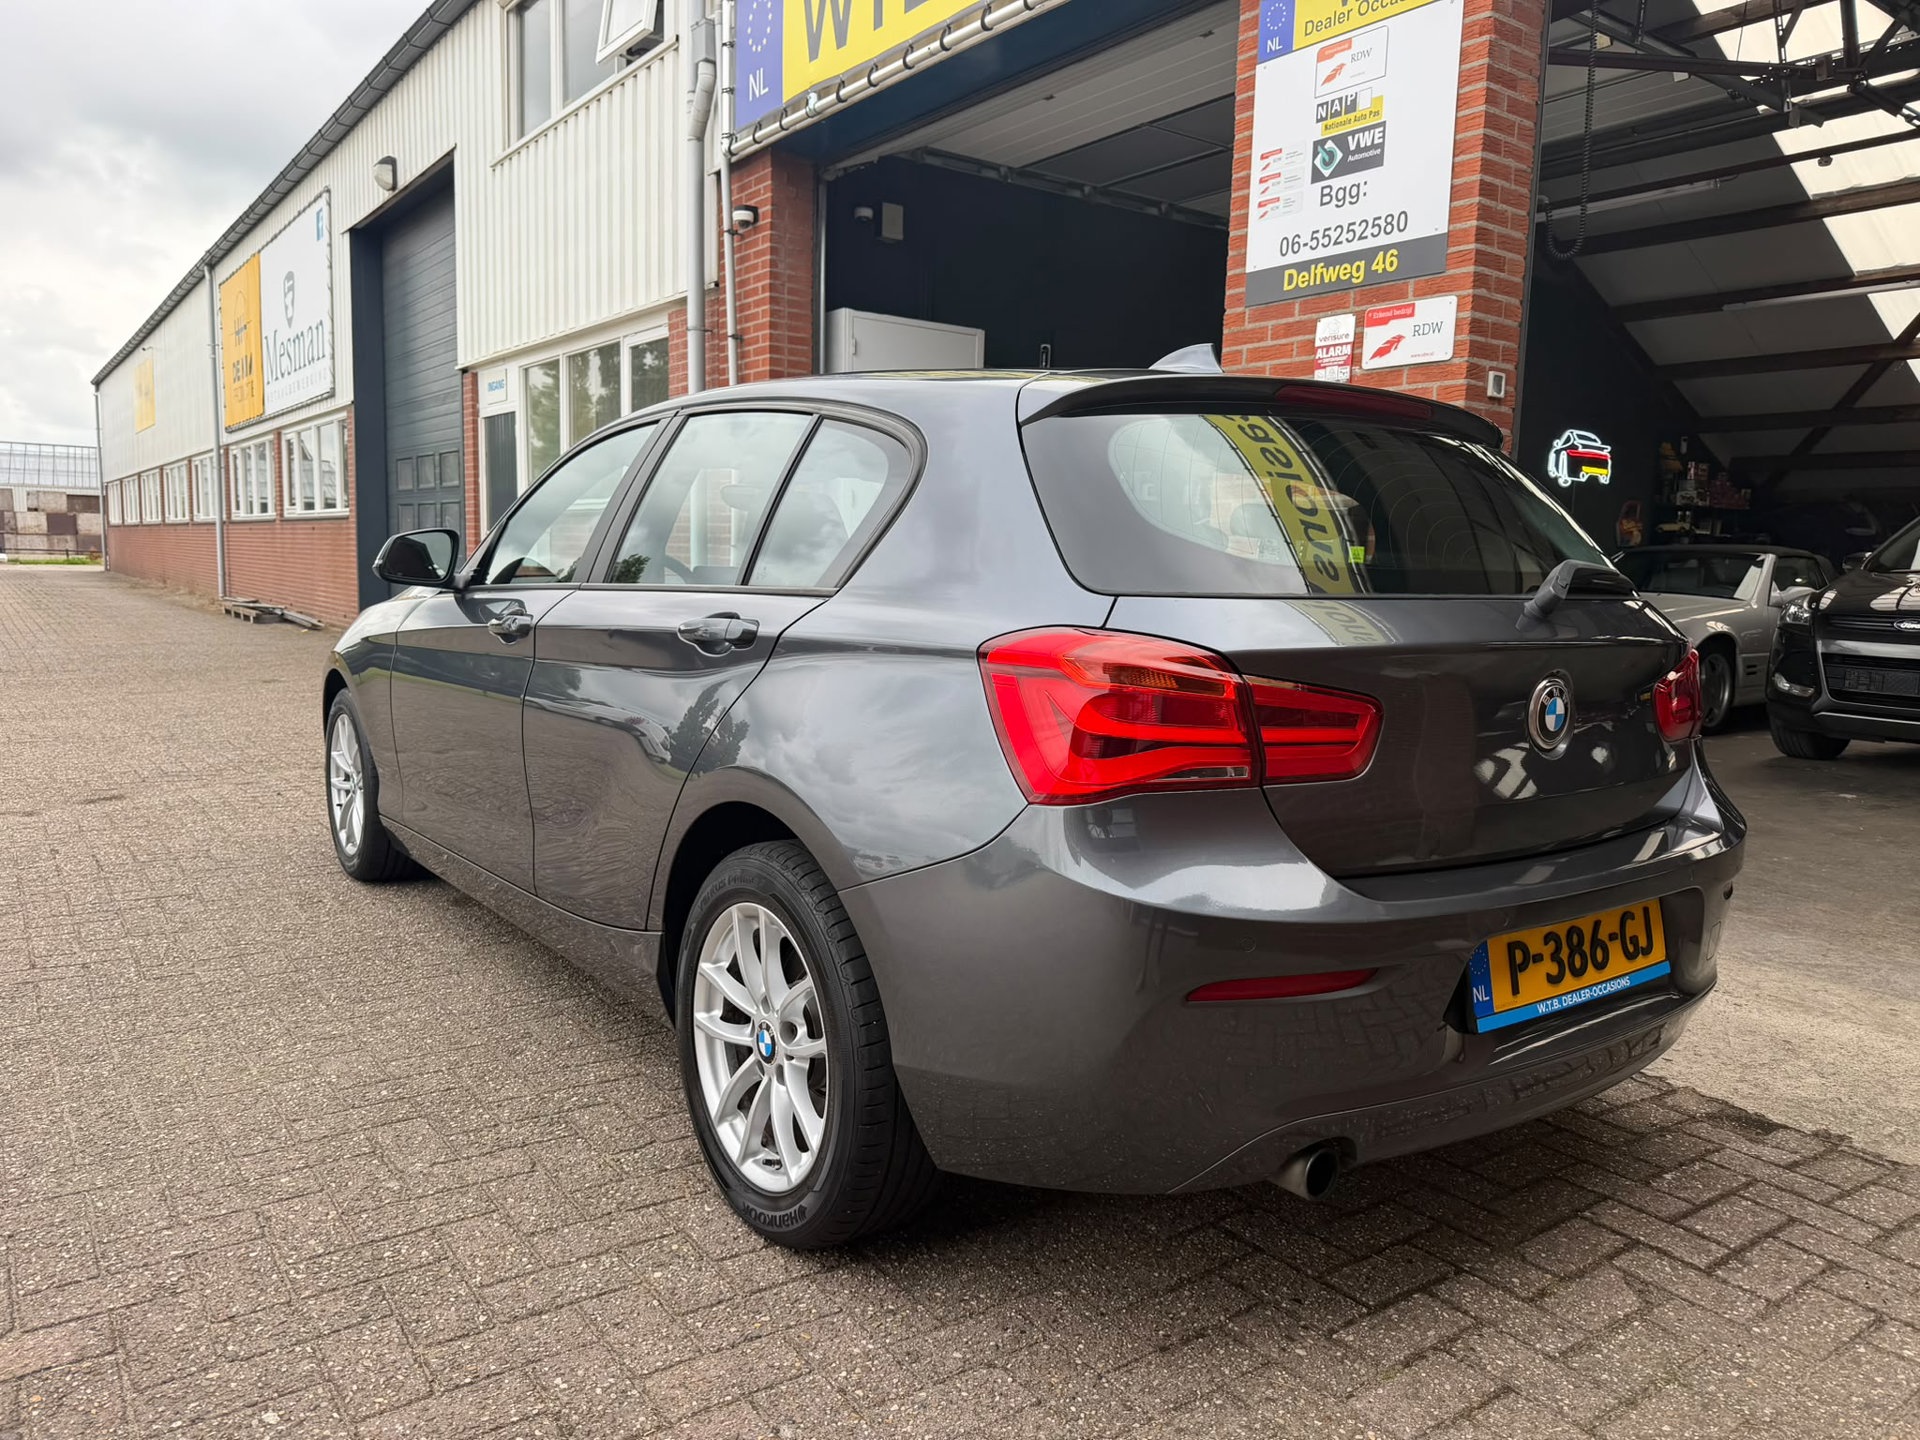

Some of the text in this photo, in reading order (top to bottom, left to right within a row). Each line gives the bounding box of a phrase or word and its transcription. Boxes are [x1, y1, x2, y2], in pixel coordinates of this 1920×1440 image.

[1304, 8, 1355, 37] Dealer
[1267, 37, 1283, 53] NL
[1350, 48, 1372, 64] RDW
[749, 68, 769, 102] NL
[1317, 93, 1357, 120] NAP
[1324, 109, 1381, 131] Nationale Auto Pas
[1347, 126, 1384, 151] VWE
[1347, 148, 1381, 162] Automotive
[1319, 180, 1368, 208] Bgg:
[1279, 210, 1409, 257] 06-55252580
[1282, 248, 1399, 291] Delfweg 46
[1412, 321, 1444, 337] RDW
[264, 319, 326, 385] Mesman
[1315, 344, 1351, 360] ALARM
[1507, 906, 1654, 997] P-386-GJ
[1472, 984, 1490, 1003] NL
[1537, 976, 1631, 1014] W.T.B. DEALER-OCCASIONS
